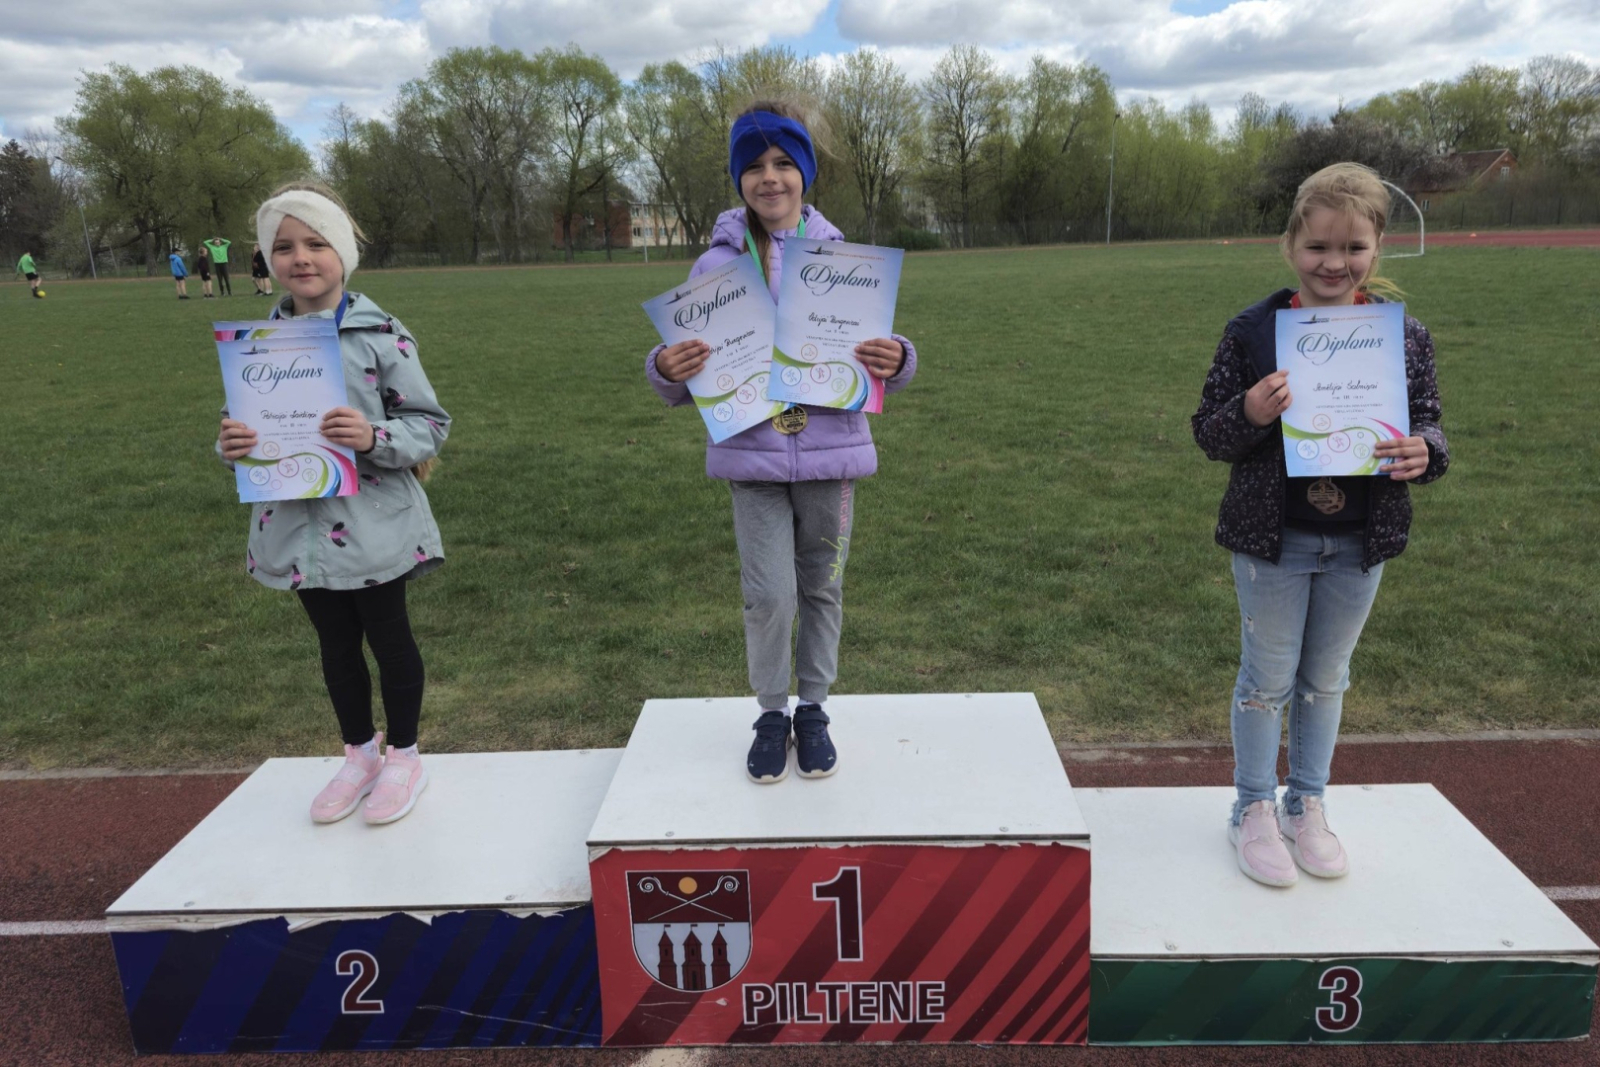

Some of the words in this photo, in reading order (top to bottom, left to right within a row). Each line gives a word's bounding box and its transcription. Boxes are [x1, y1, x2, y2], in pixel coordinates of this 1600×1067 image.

[812, 866, 863, 962] 1
[335, 949, 385, 1014] 2
[742, 981, 945, 1025] PILTENE
[1315, 965, 1363, 1032] 3
